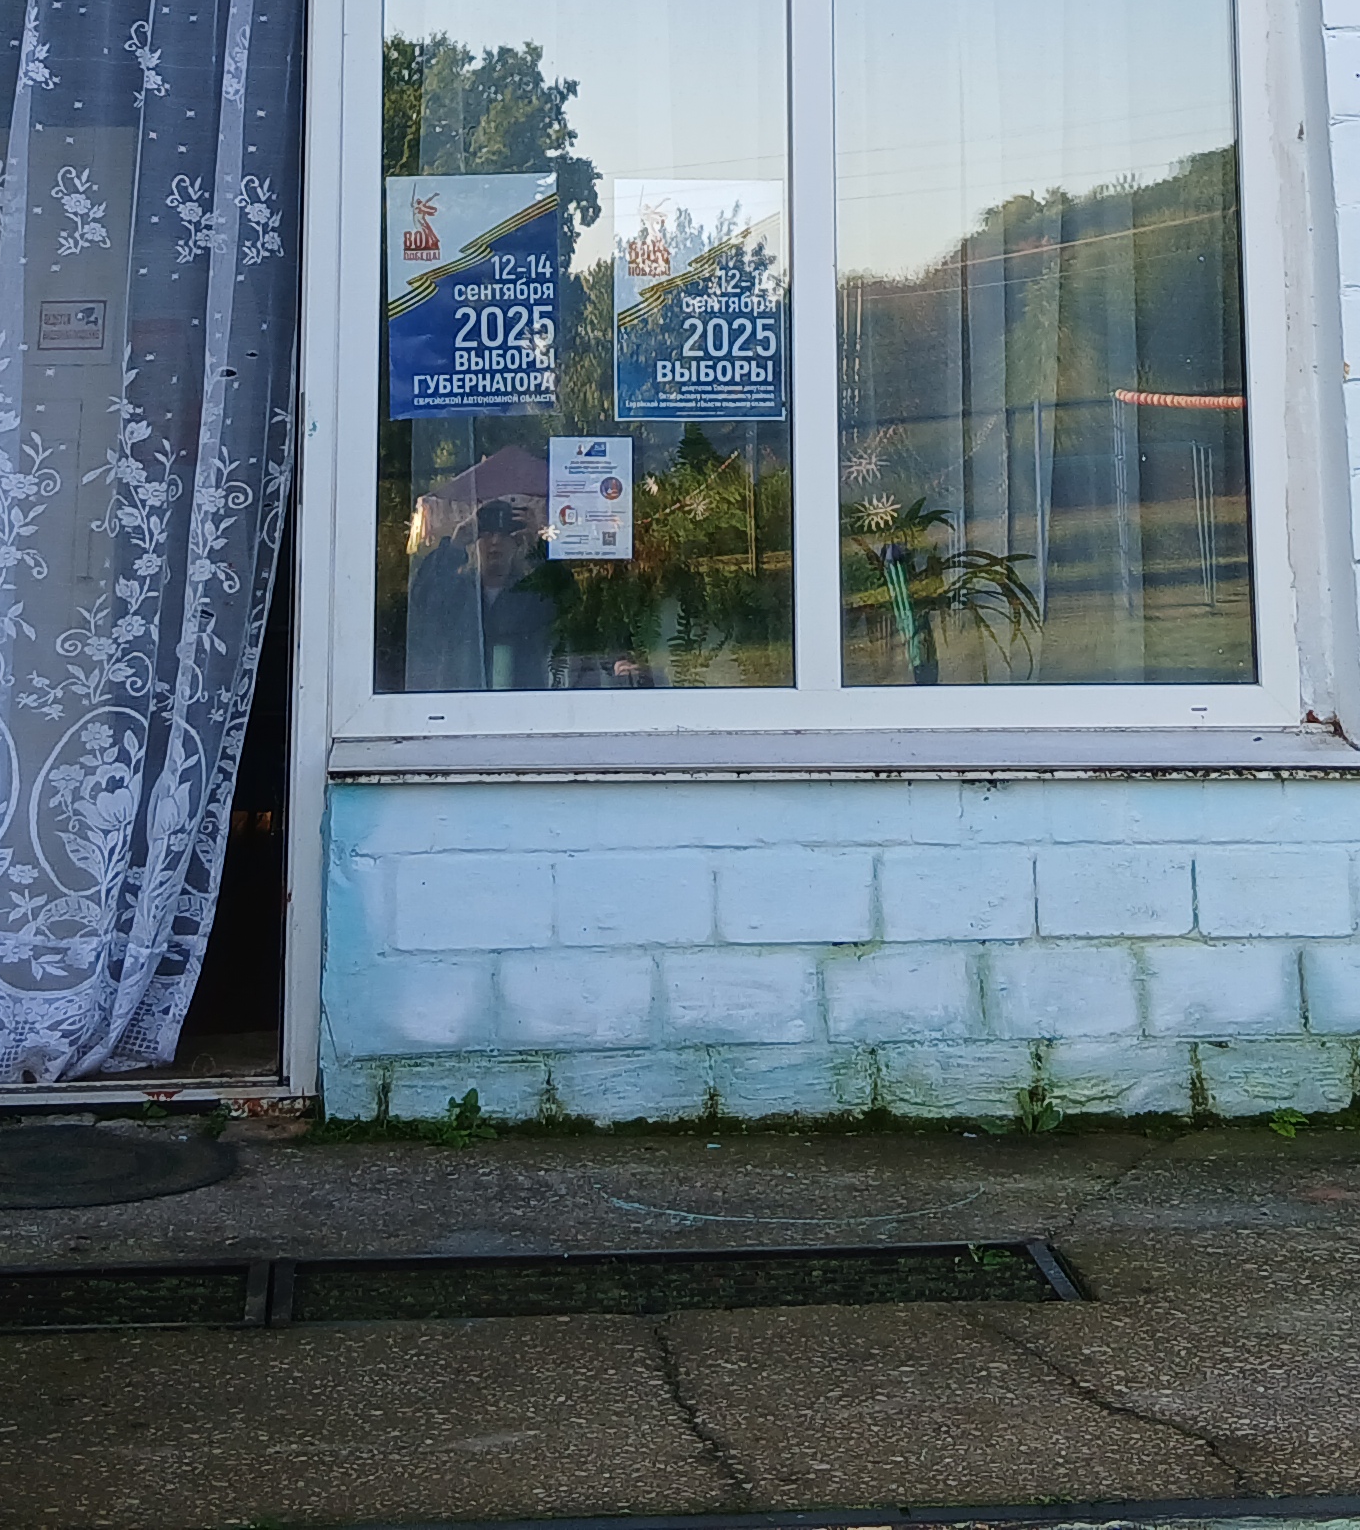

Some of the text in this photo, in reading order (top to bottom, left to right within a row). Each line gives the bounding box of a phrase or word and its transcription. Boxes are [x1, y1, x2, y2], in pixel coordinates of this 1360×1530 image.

[491, 254, 553, 279] 12-14
[454, 279, 554, 303] сентября
[682, 291, 777, 317] сентября
[455, 306, 555, 347] 2025
[682, 318, 777, 357] 2025
[455, 349, 555, 370] ВЫБОРЫ
[656, 360, 774, 382] ВЫБОРЫ
[414, 372, 556, 395] ГУБЕРНАТОРА
